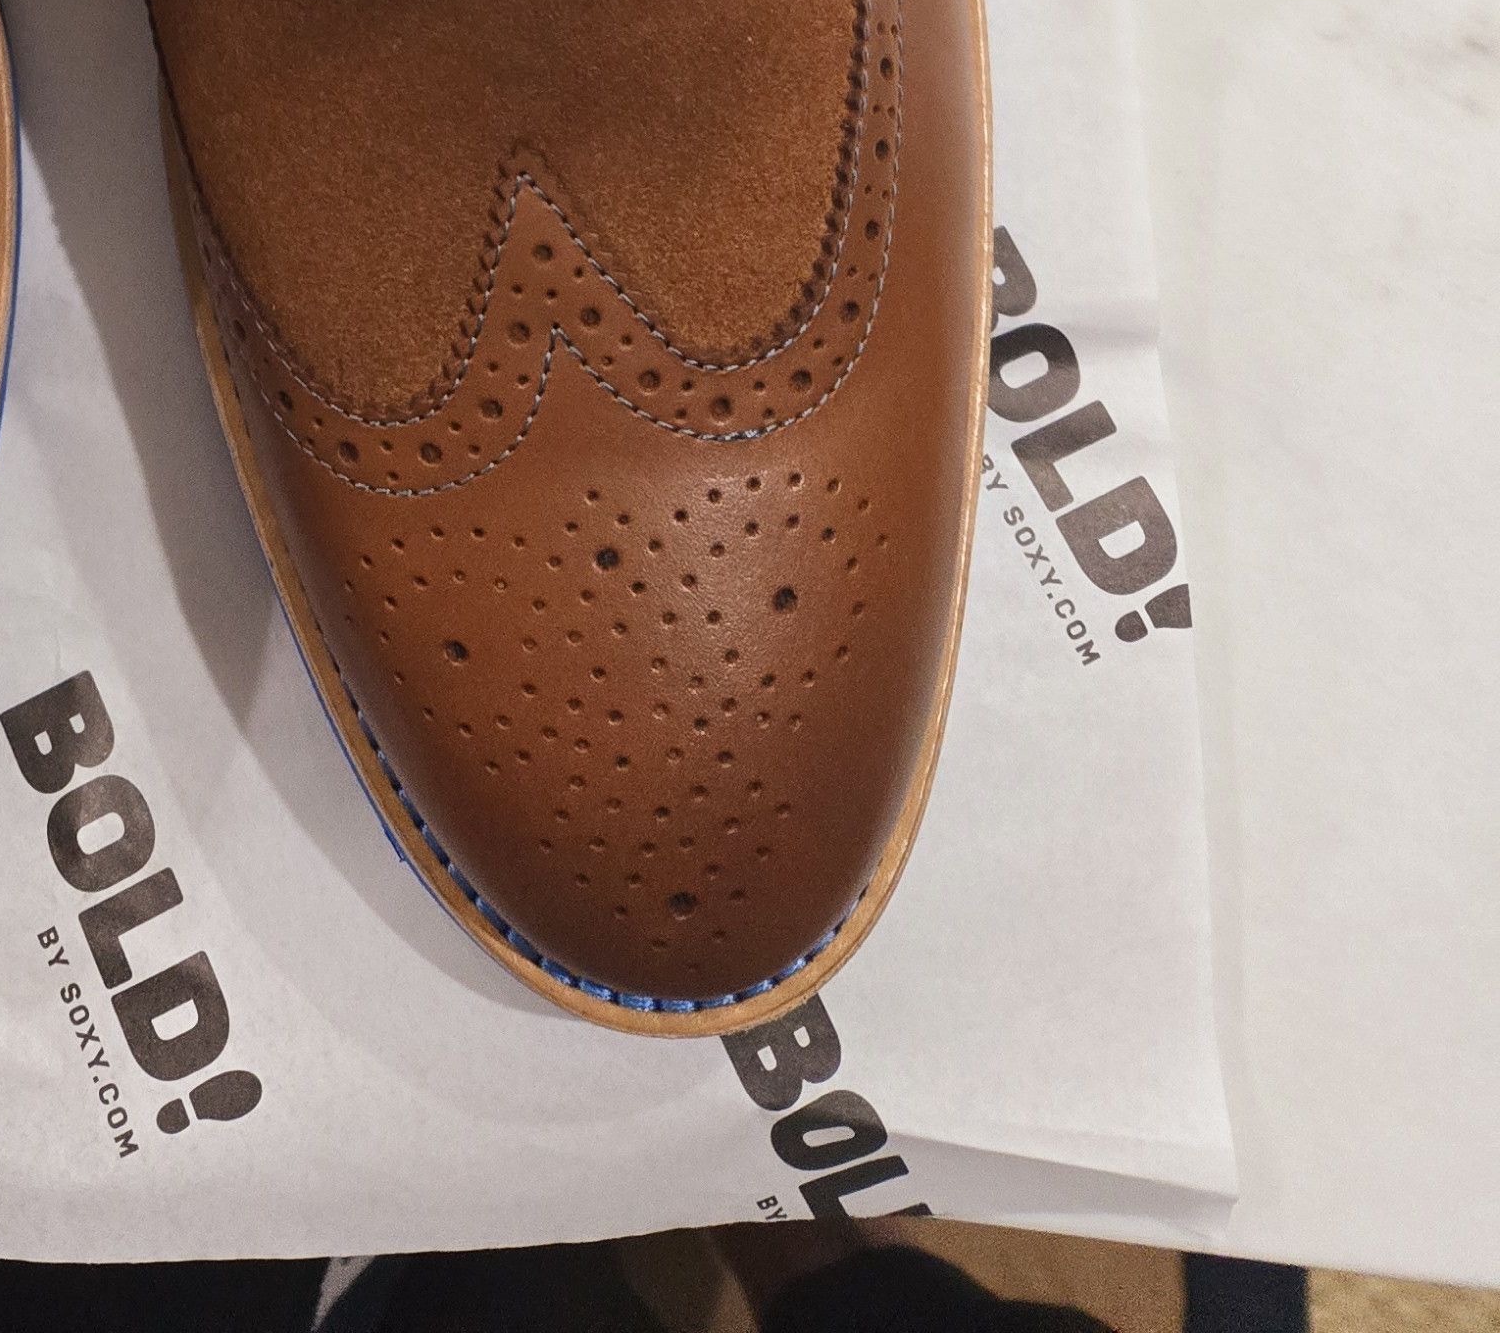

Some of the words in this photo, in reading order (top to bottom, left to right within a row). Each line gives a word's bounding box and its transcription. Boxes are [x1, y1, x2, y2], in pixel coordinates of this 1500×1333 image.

[1003, 505, 1101, 667] SOXY.COM
[0, 670, 263, 1135] BOLD!
[37, 926, 69, 968] BY
[60, 982, 140, 1159] SOXY.COM
[720, 992, 933, 1219] BOL
[756, 1195, 788, 1221] BY
